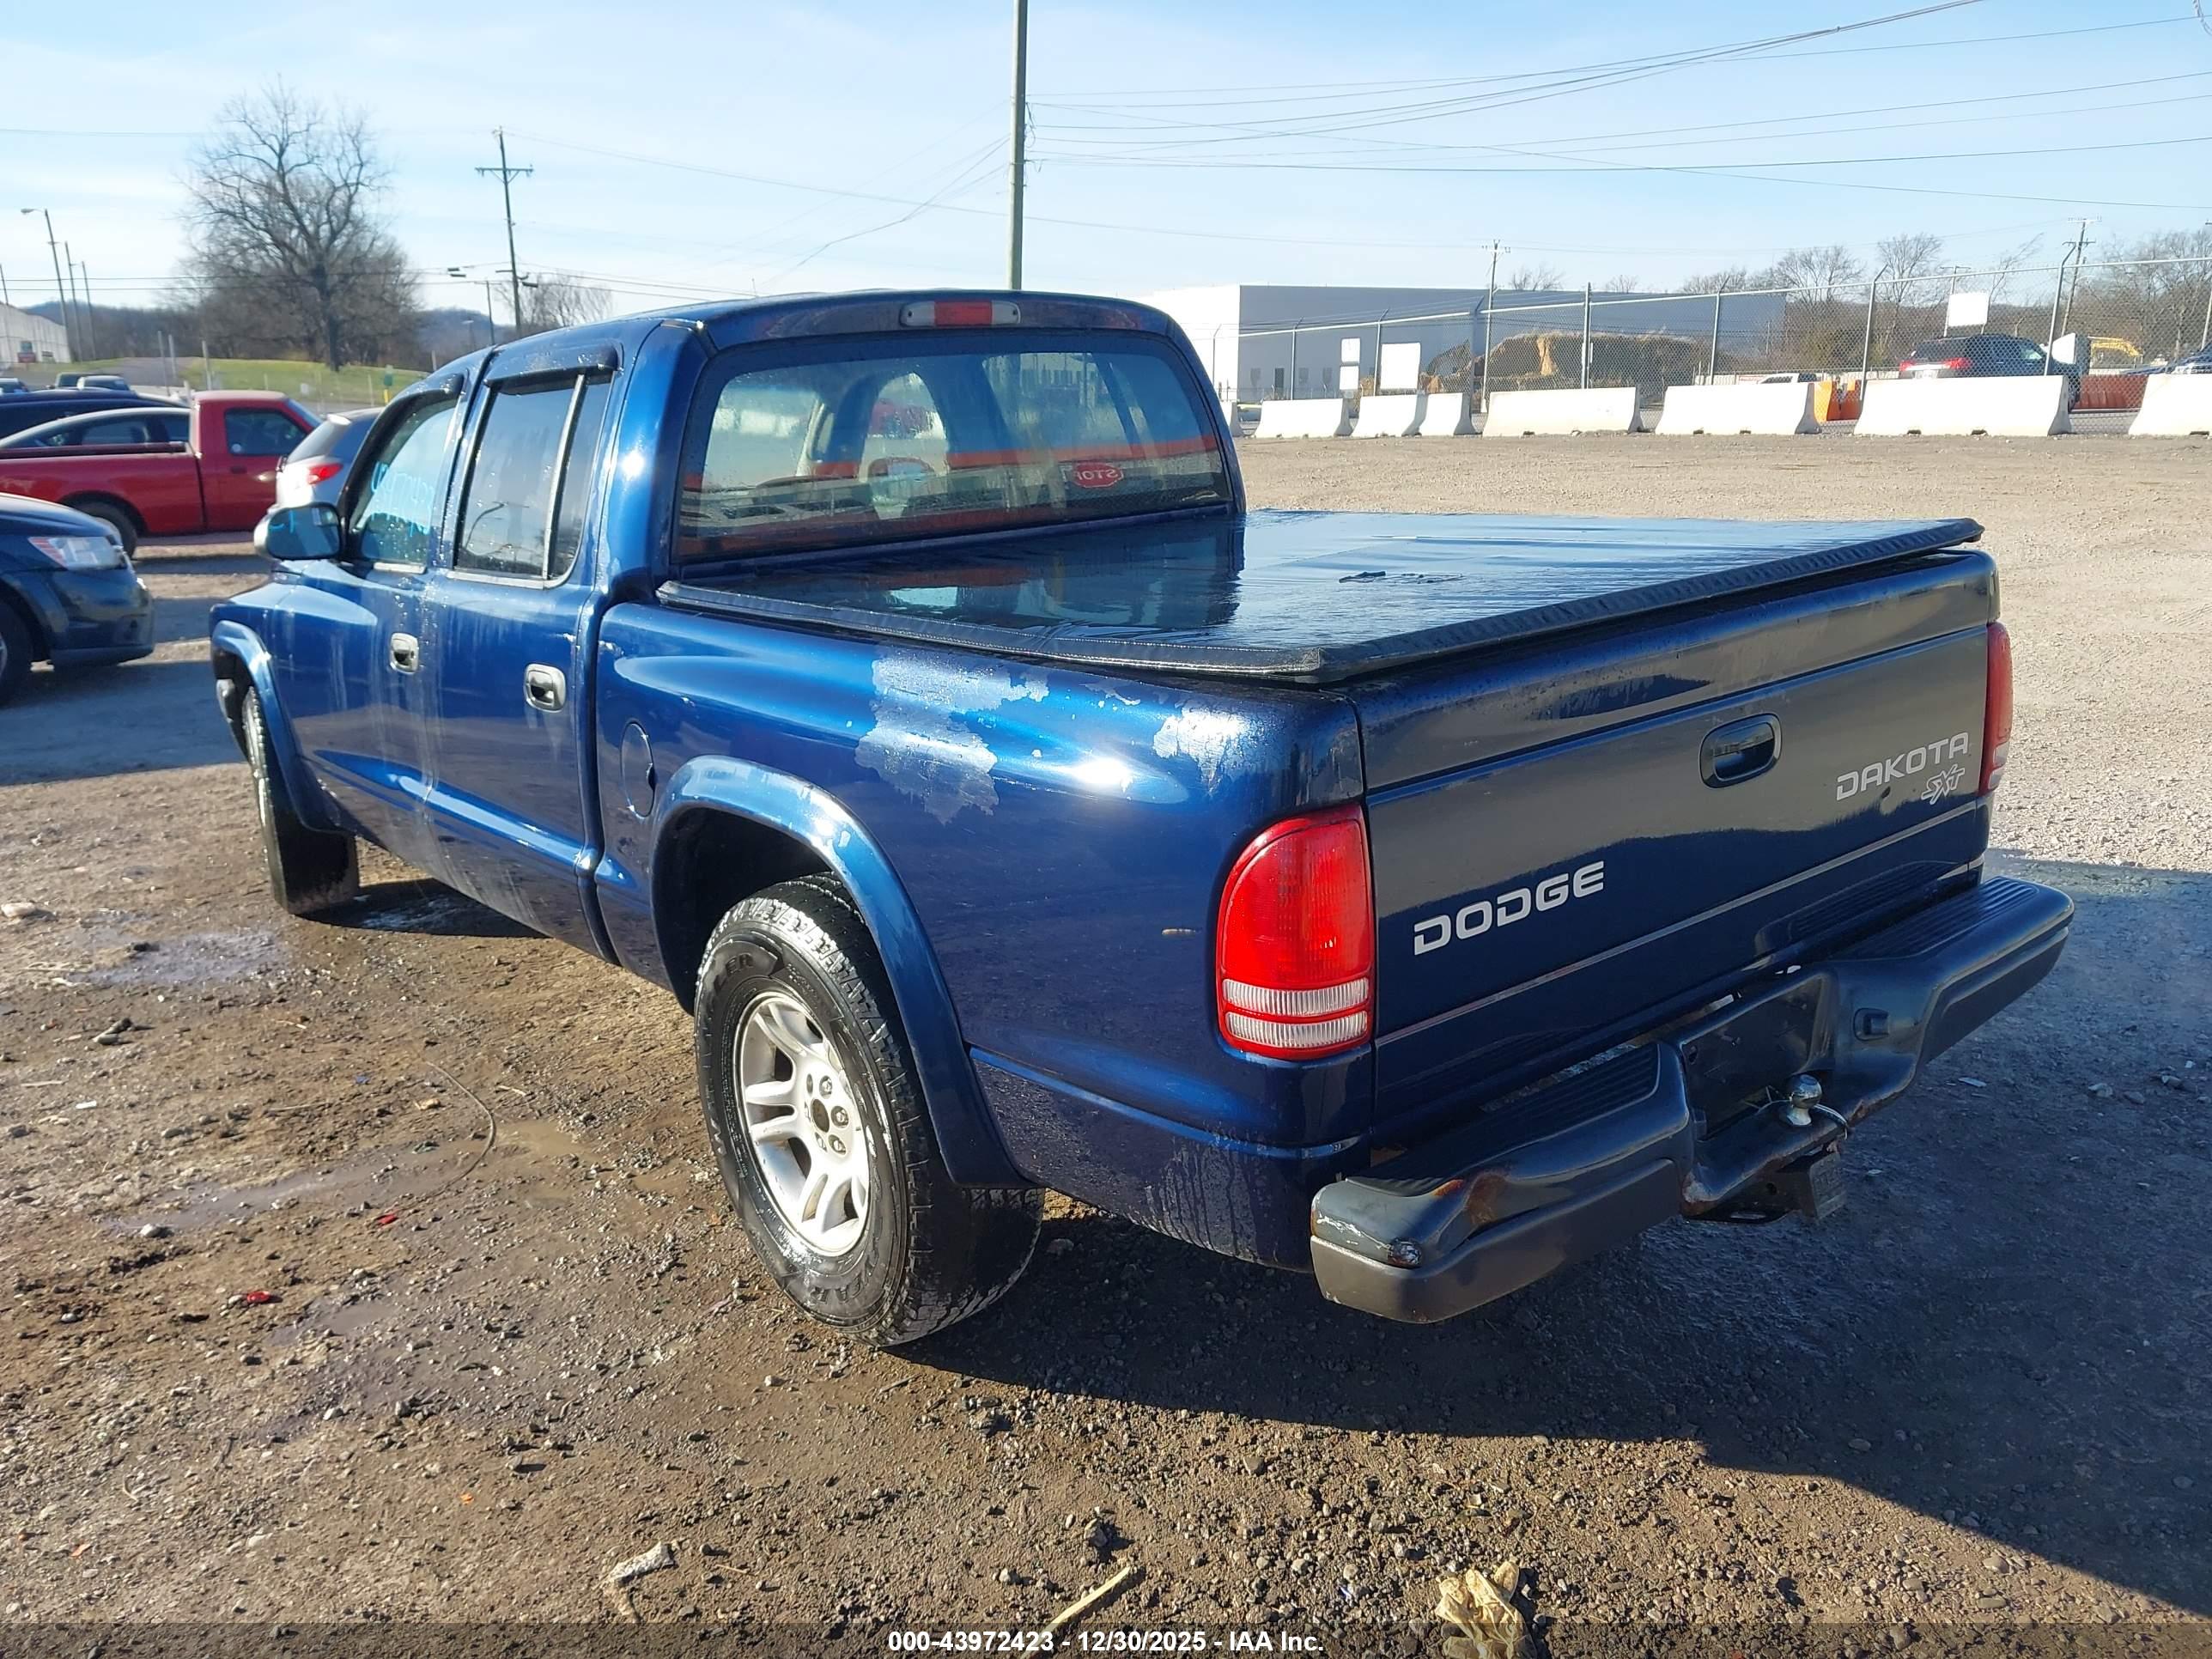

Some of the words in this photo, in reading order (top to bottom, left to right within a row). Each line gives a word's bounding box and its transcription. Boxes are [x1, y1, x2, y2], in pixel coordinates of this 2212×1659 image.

[1836, 732, 1969, 801] DAKOTA
[1921, 763, 1966, 805] SXT
[1413, 860, 1604, 956] DODGE
